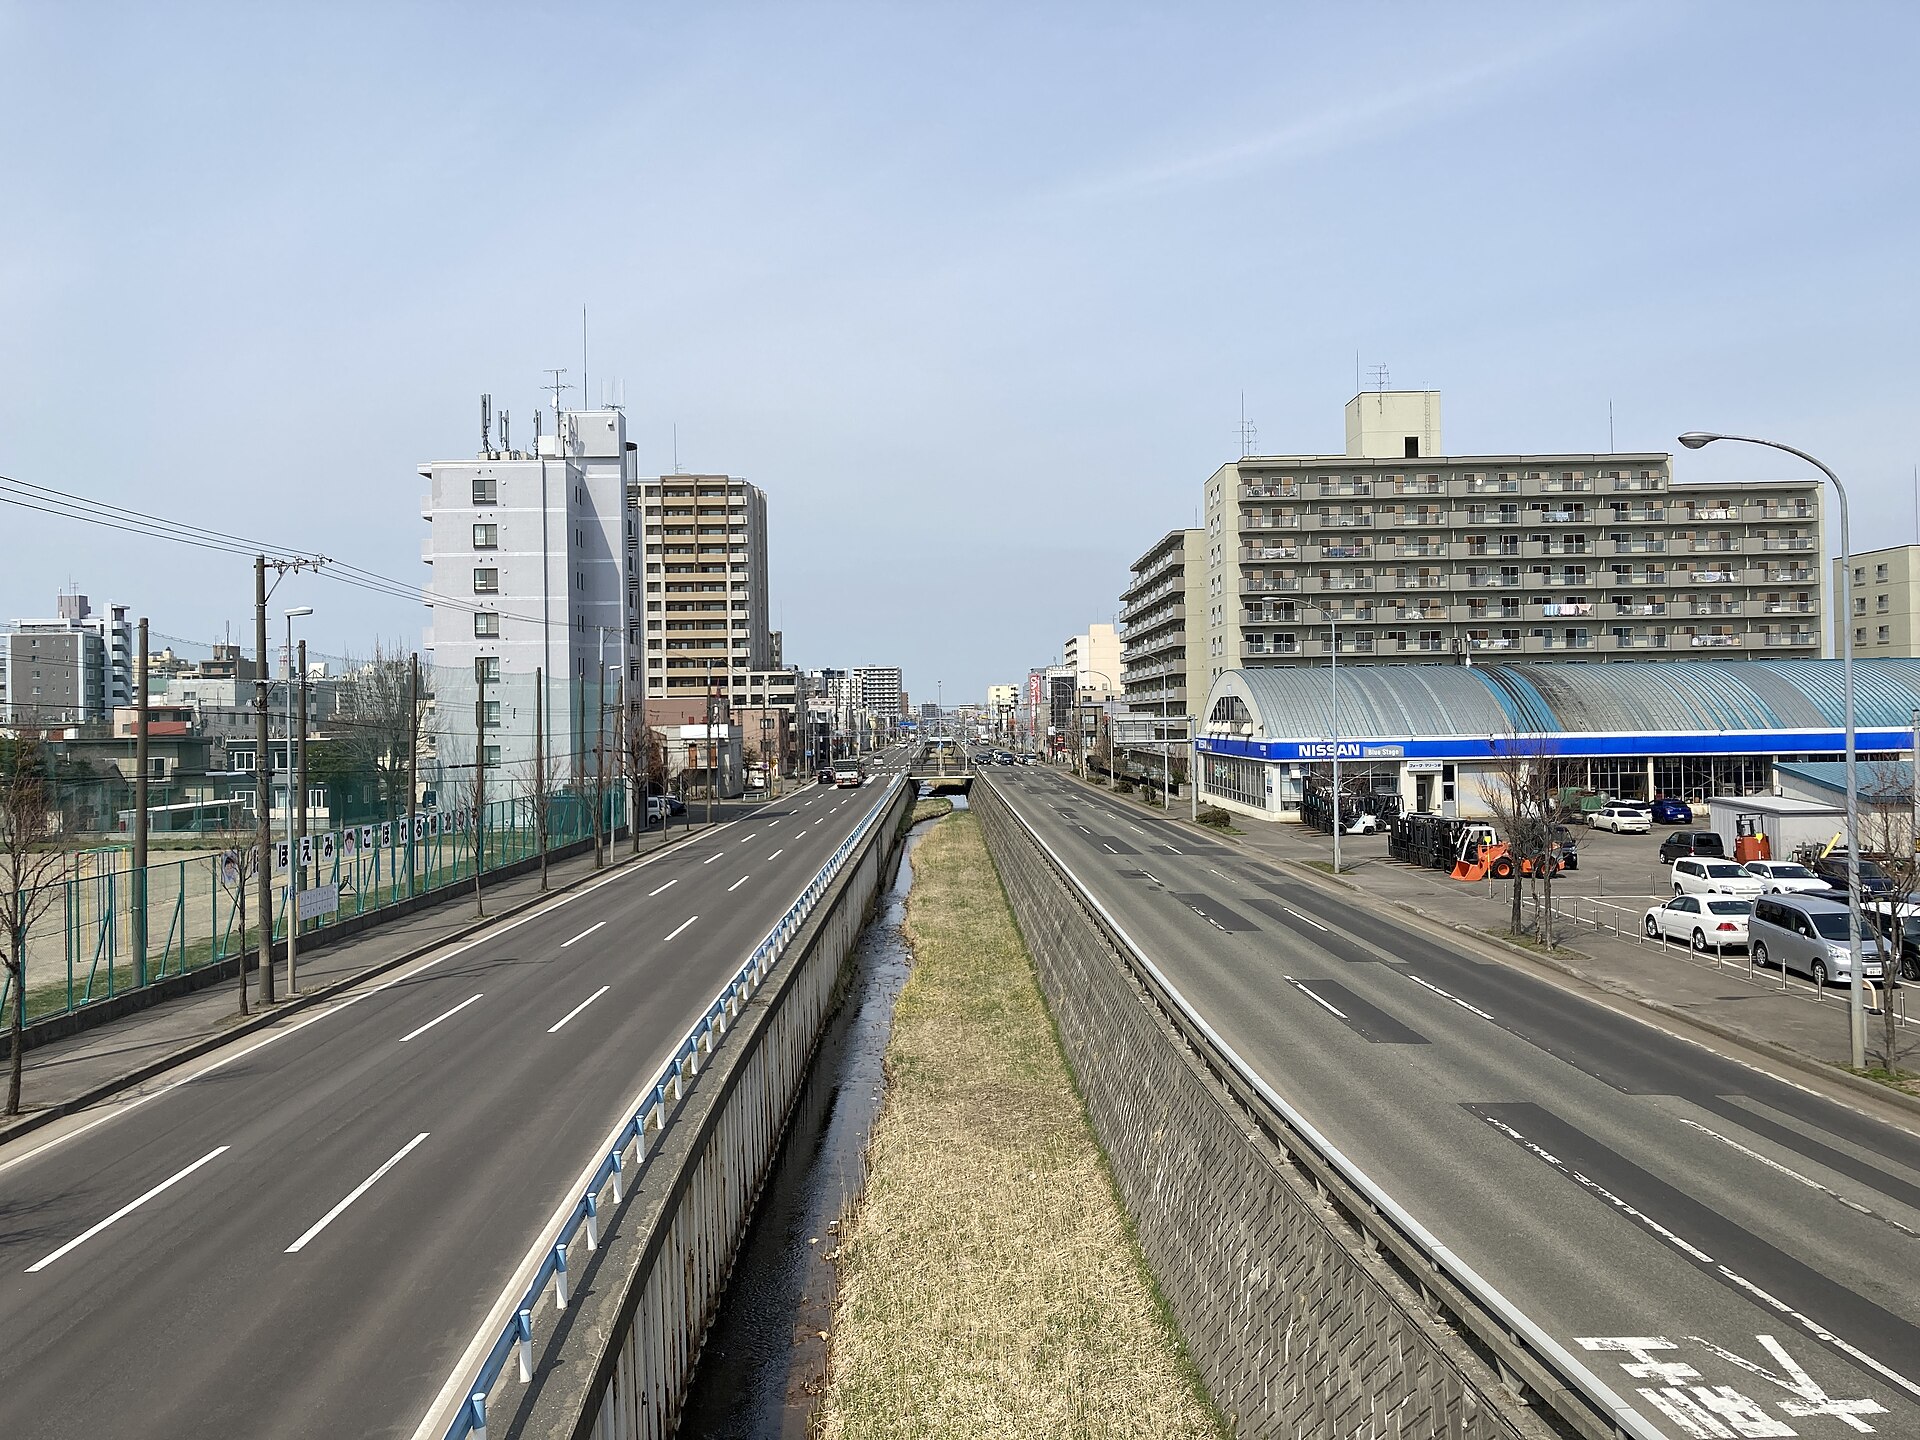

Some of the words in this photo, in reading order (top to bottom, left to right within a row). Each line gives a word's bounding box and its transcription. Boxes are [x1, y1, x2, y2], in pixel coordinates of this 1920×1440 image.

[1299, 744, 1360, 756] NISSAN
[1368, 748, 1381, 756] Blue
[1382, 748, 1399, 757] Stage
[1572, 1335, 1891, 1440] 大型
